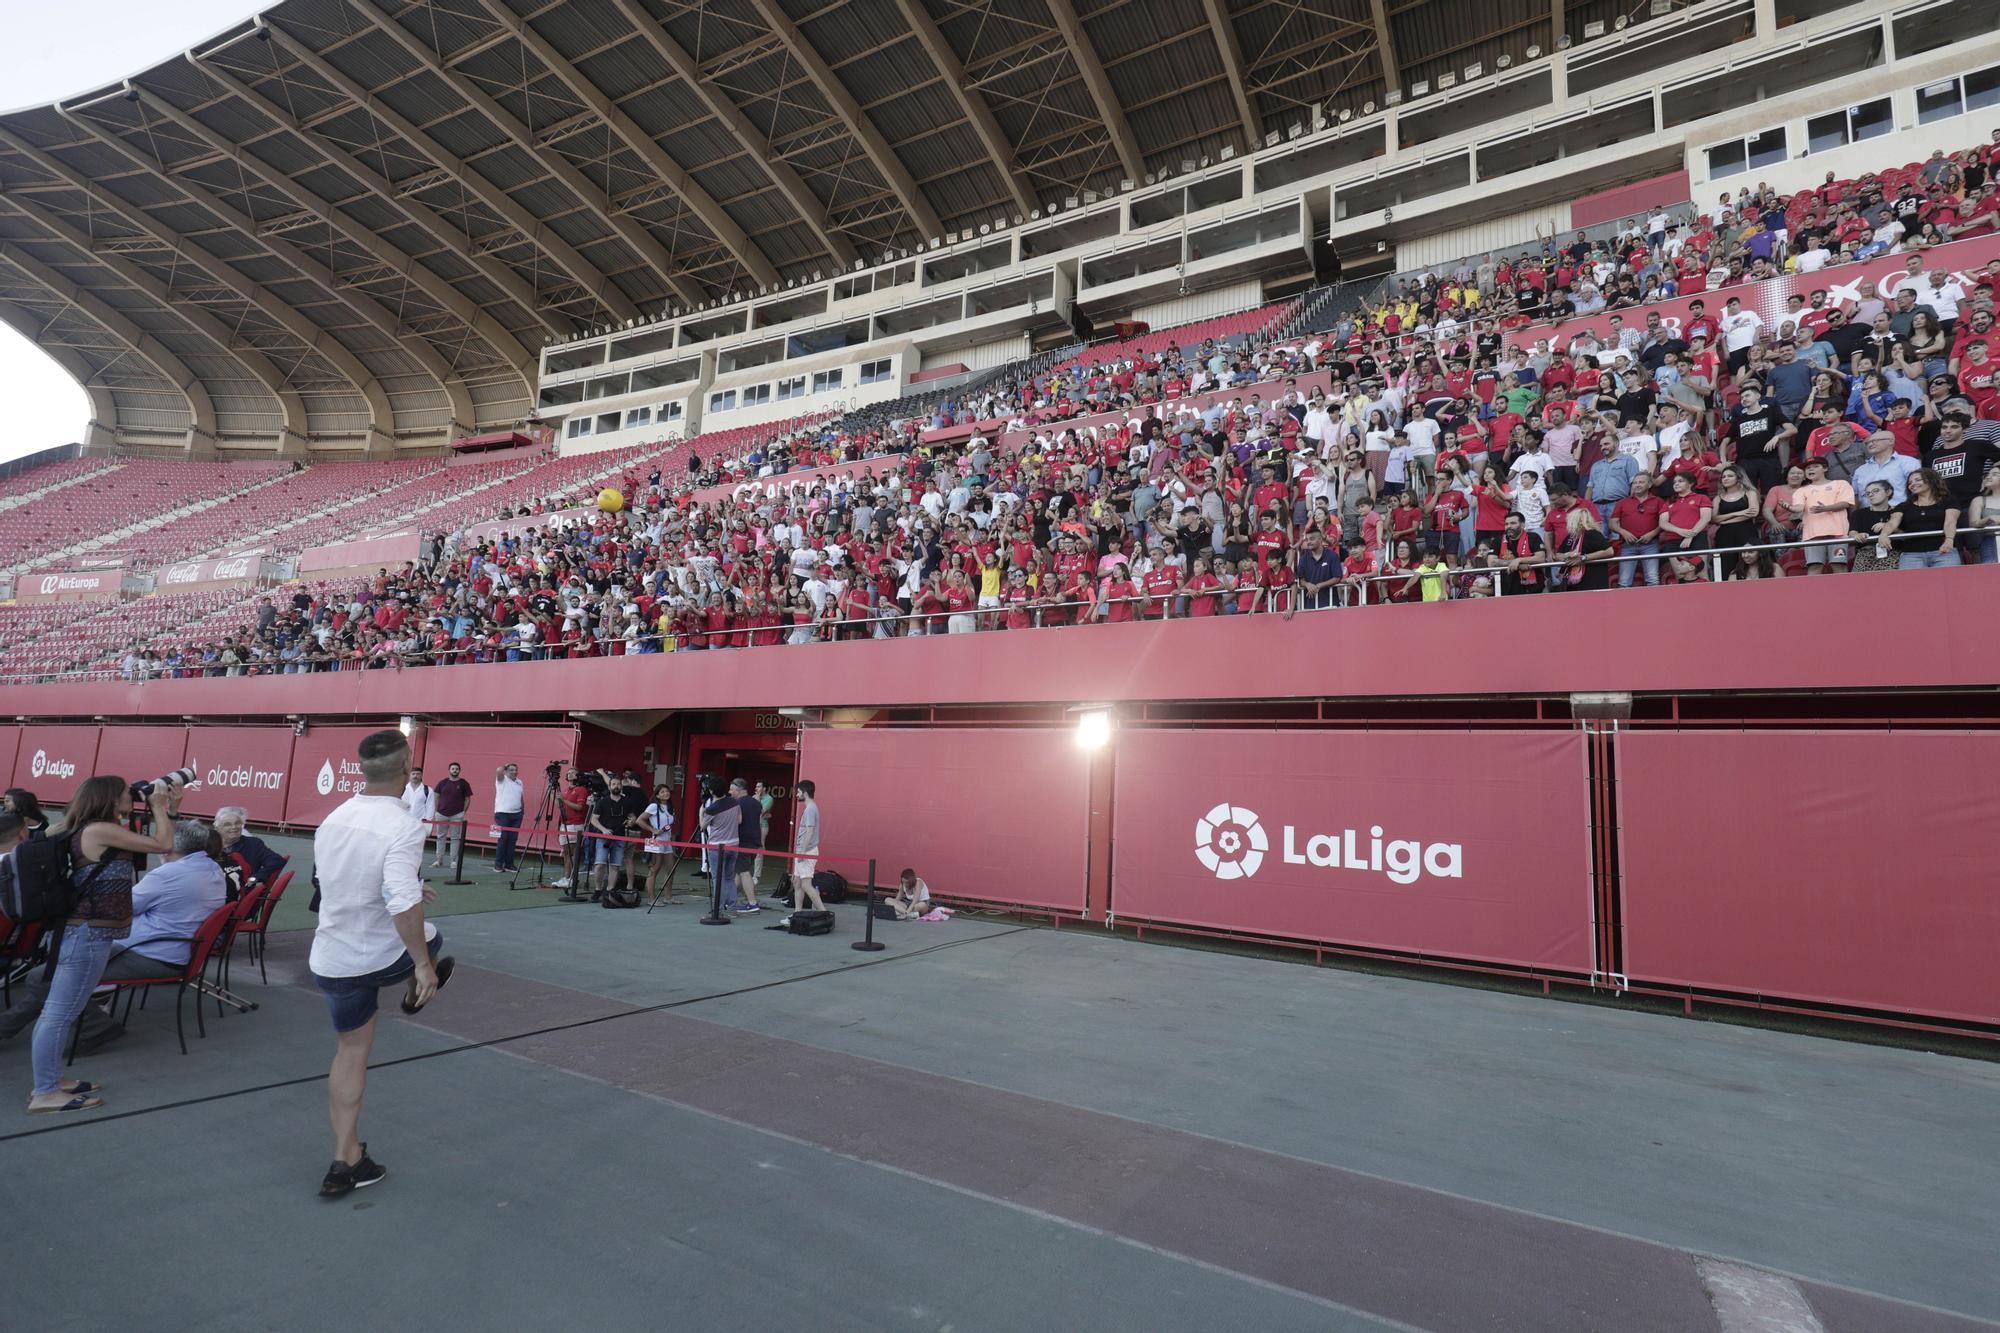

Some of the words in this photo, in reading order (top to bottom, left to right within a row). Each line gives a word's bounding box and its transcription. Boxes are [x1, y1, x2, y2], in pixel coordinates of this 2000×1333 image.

[1933, 458, 1963, 471] STREET
[754, 713, 781, 729] RCD
[45, 758, 75, 779] LaLiga
[230, 765, 253, 788] del
[253, 771, 284, 790] mar
[337, 775, 351, 793] de
[1283, 825, 1462, 884] LaLiga
